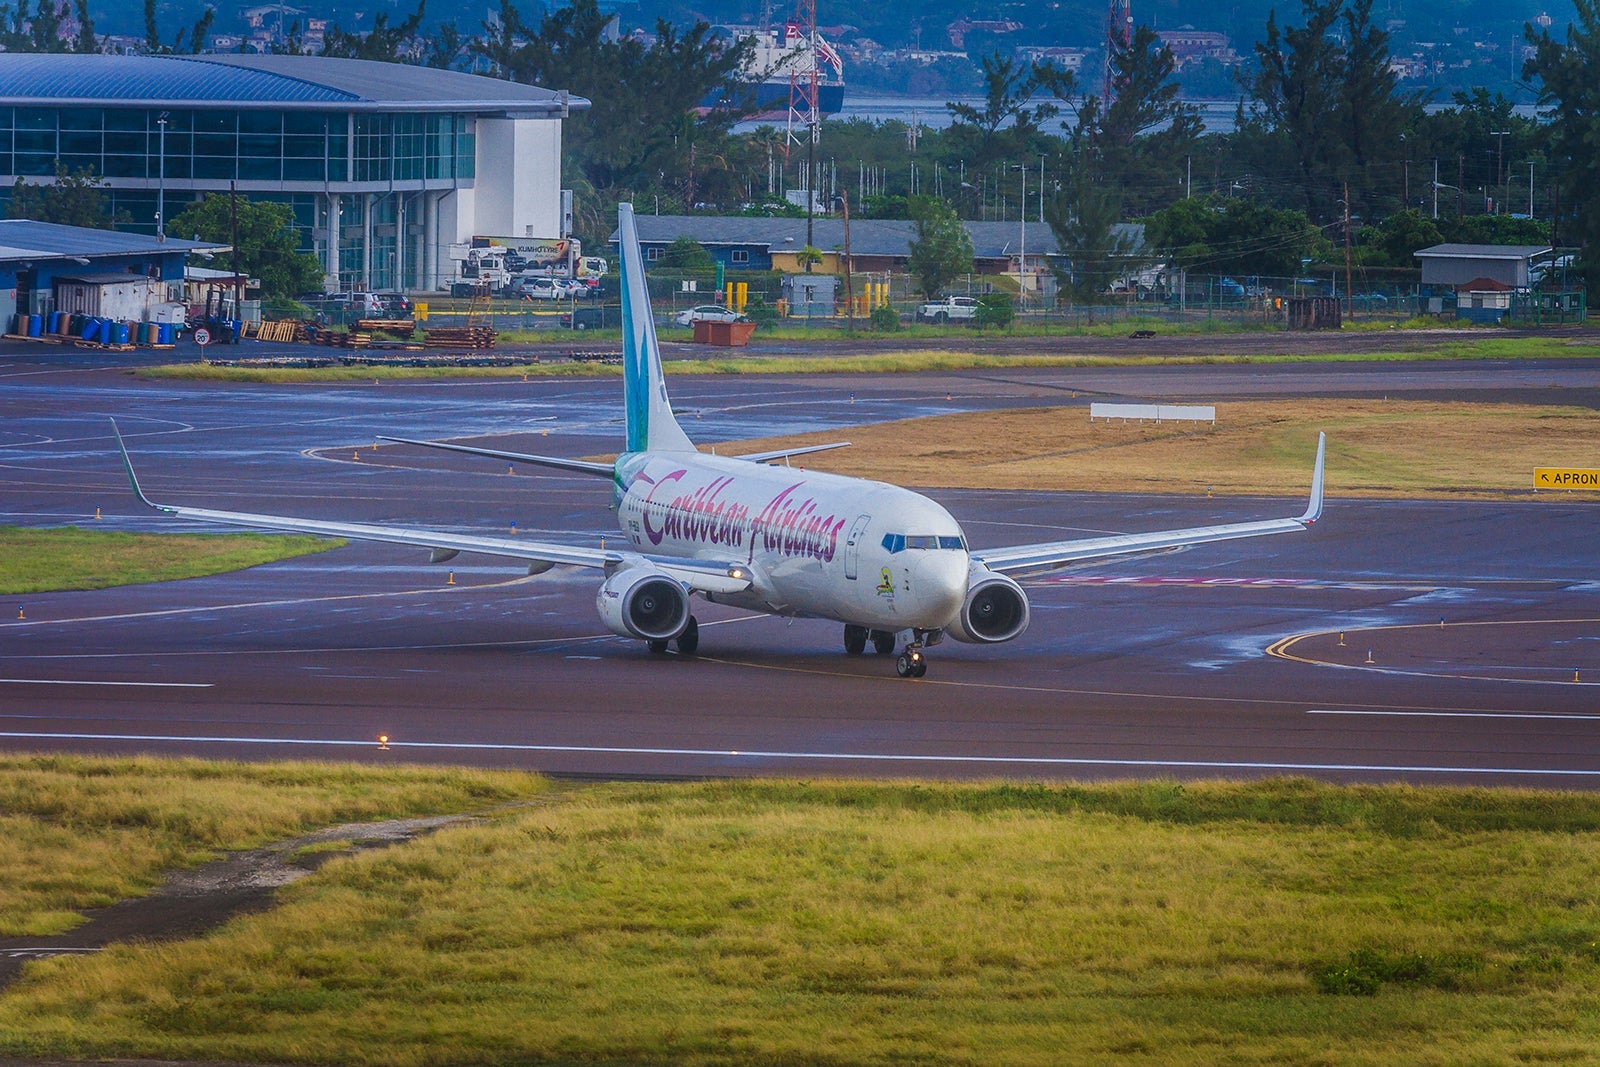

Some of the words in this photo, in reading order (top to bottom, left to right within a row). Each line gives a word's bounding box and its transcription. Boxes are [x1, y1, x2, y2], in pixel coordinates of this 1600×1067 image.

[1554, 473, 1598, 485] APRON
[642, 469, 748, 546] Caribbean
[747, 480, 845, 566] Airlines
